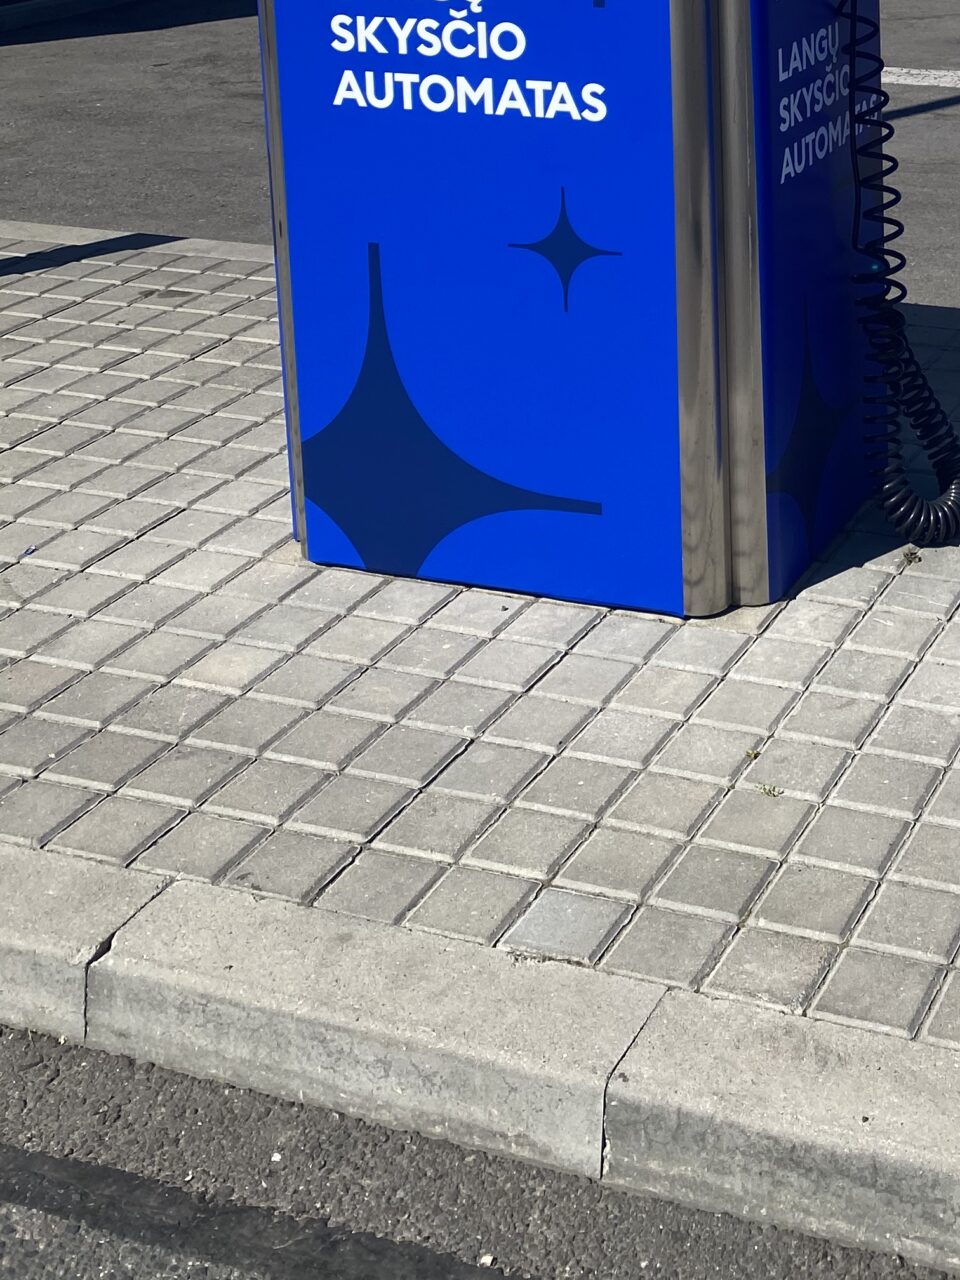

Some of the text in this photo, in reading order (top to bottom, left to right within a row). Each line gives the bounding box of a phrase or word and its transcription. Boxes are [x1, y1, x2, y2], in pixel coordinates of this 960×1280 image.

[330, 8, 527, 61] SKYSČIO
[777, 21, 840, 83] LANGŲ
[332, 69, 608, 122] AUTOMATAS
